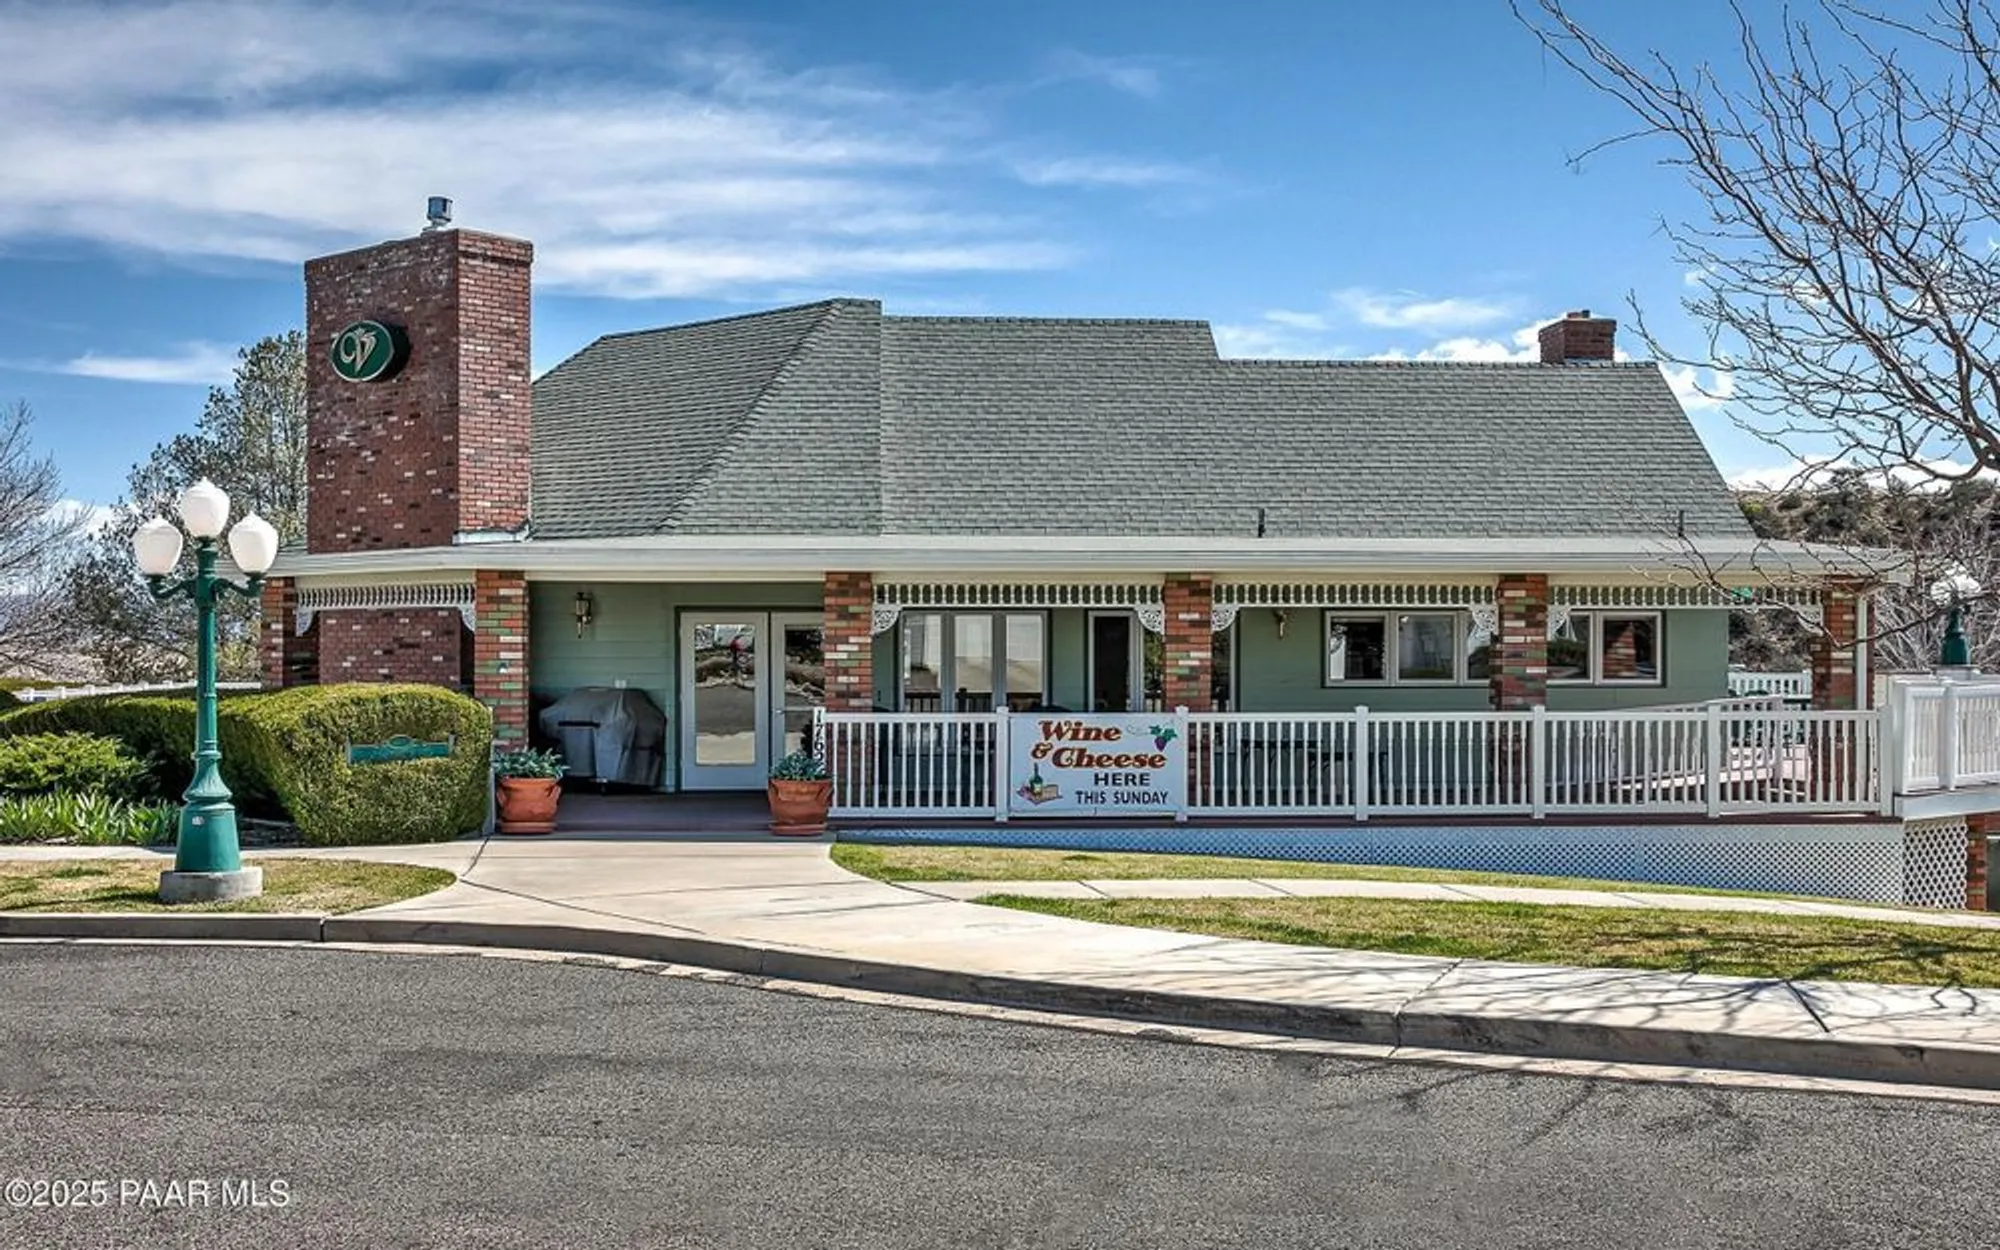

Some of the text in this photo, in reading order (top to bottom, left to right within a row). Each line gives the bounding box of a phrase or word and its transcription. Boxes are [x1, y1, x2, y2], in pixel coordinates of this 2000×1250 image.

[1038, 720, 1122, 741] Wine
[1031, 742, 1167, 768] & Cheese
[1094, 772, 1150, 787] HERE
[1075, 790, 1168, 805] THIS SUNDAY
